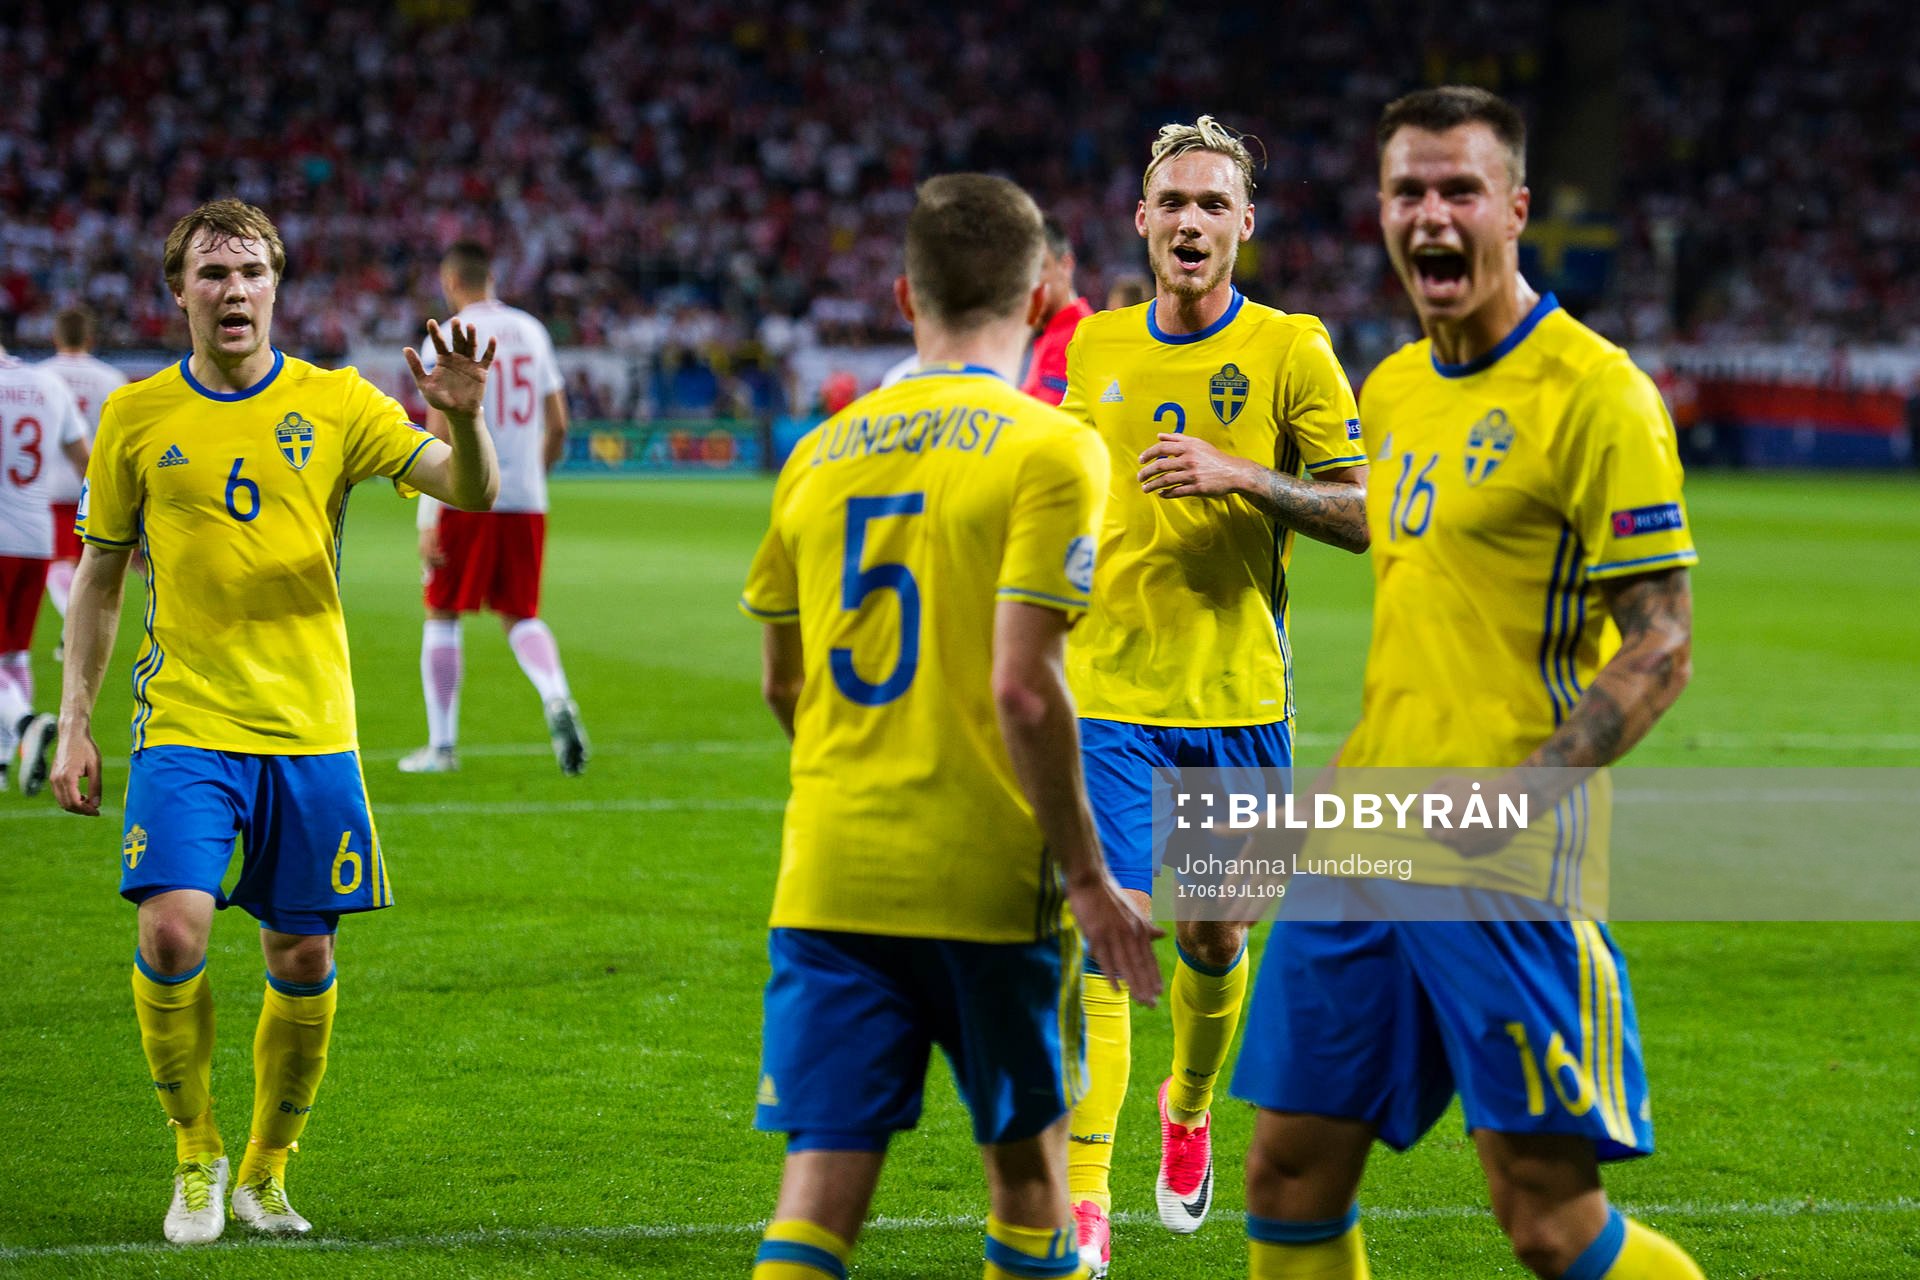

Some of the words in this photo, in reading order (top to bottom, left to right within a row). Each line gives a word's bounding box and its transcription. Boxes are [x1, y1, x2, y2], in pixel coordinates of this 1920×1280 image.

[494, 354, 536, 428] 15
[811, 407, 1014, 467] LUNDQVIST
[225, 457, 261, 522] 6
[1390, 453, 1439, 542] 16
[828, 491, 925, 708] 5
[331, 831, 363, 895] 6
[1505, 1021, 1593, 1117] 16
